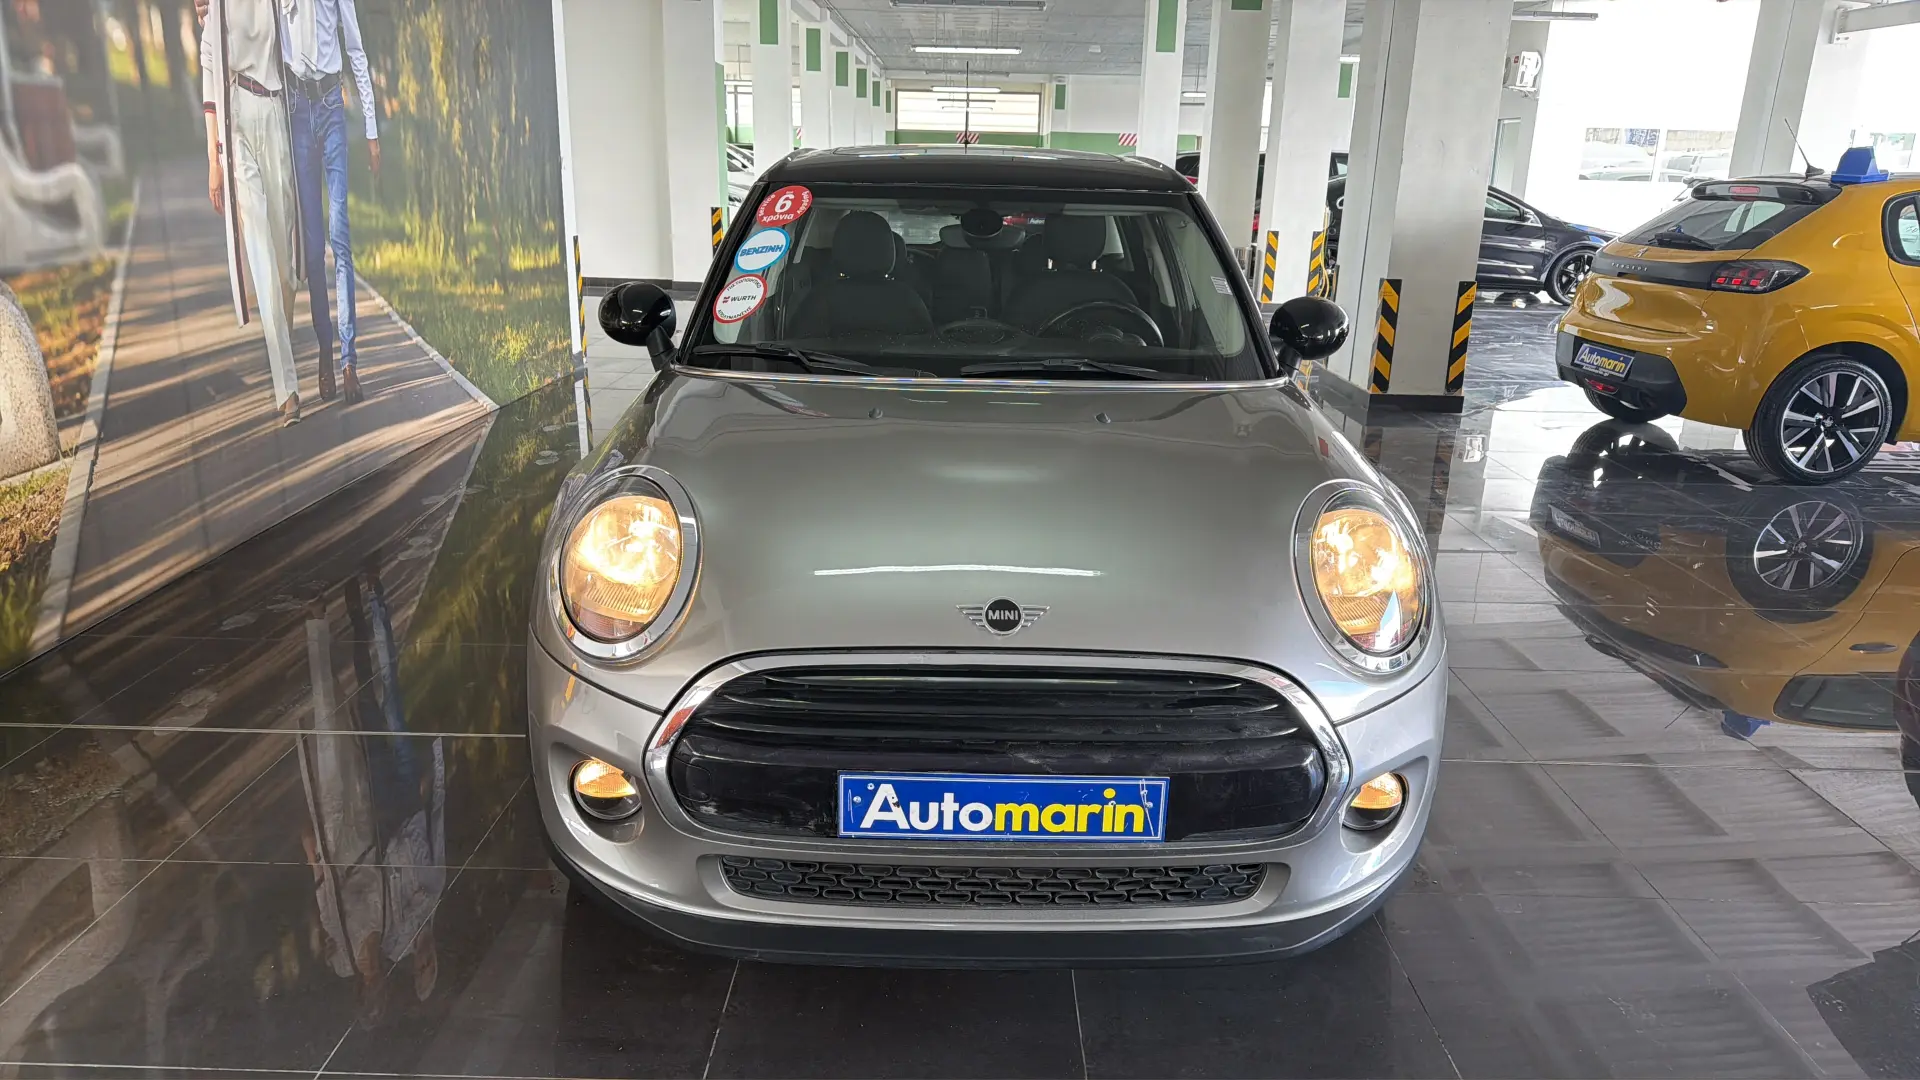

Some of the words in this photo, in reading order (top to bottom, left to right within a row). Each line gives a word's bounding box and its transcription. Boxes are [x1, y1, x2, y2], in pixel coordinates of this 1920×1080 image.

[774, 193, 795, 213] 6
[762, 212, 795, 223] χρόνια
[1579, 347, 1626, 373] Automarin
[988, 609, 1019, 620] MINI
[859, 783, 1144, 833] Automarin
